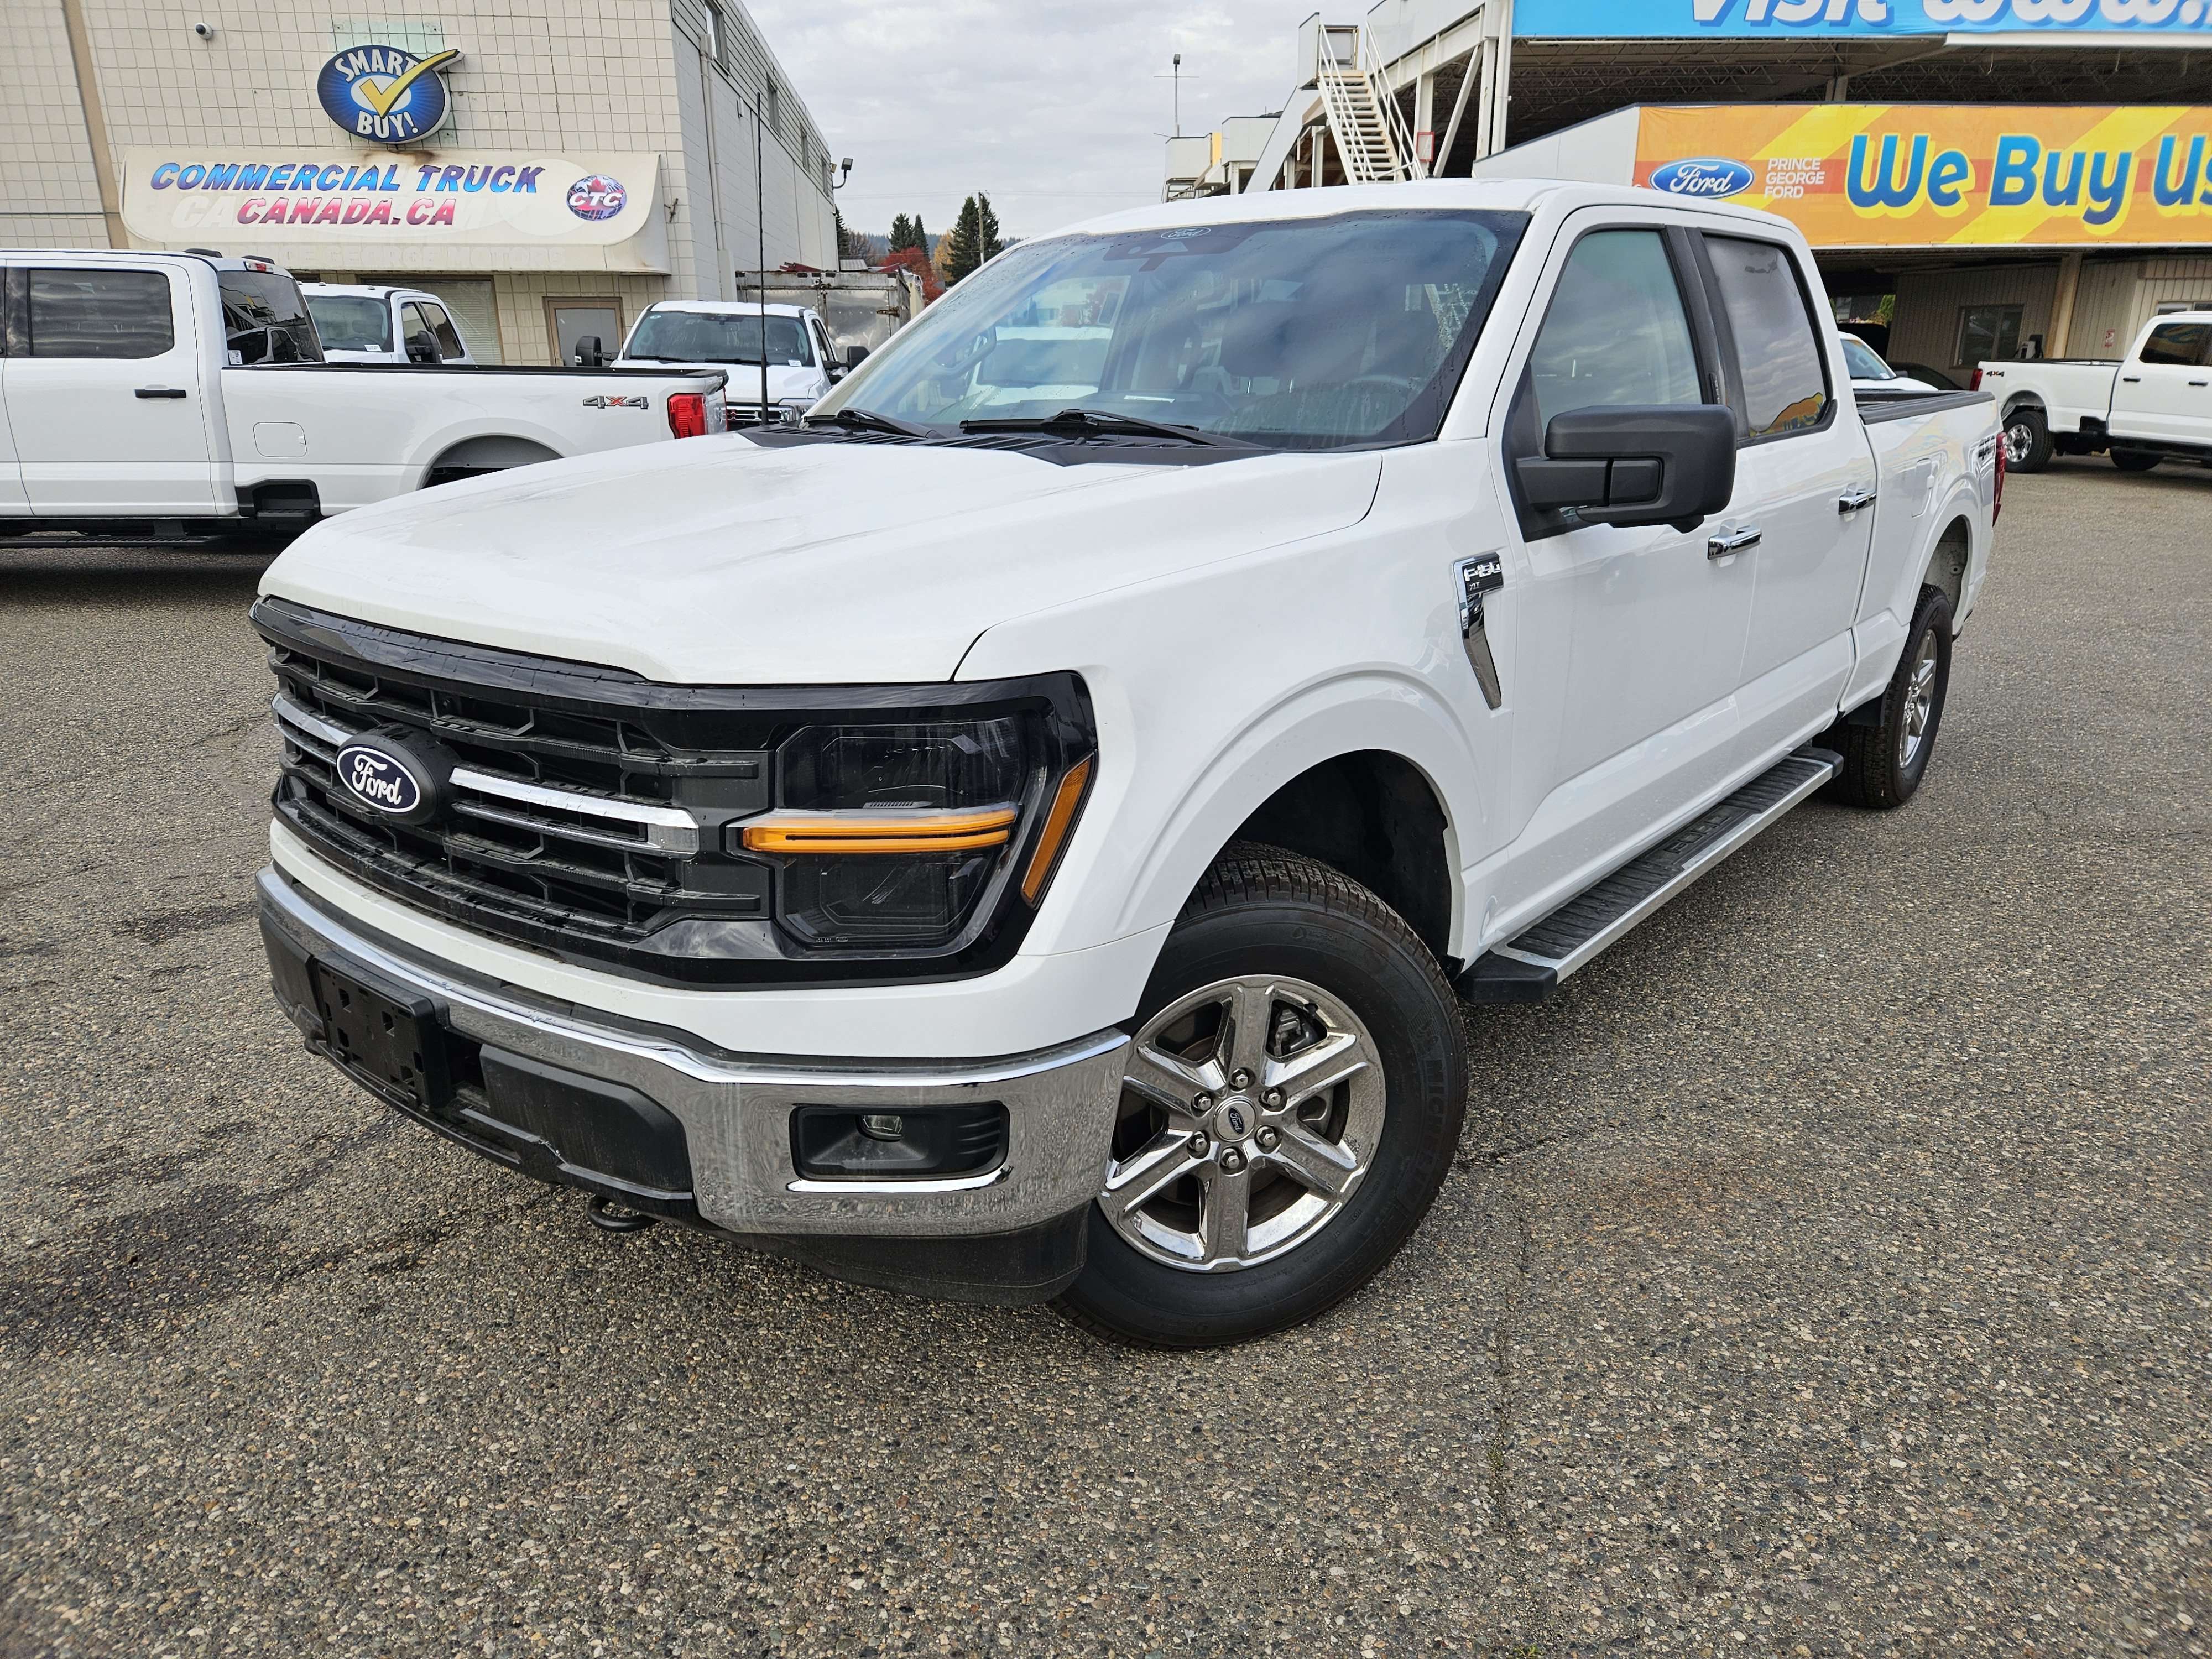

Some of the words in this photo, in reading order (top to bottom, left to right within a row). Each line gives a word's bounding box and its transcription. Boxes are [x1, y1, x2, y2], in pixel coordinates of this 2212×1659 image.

[335, 49, 419, 82] SMART
[357, 110, 419, 138] BUY!
[150, 162, 400, 191] COMMERCIAL
[416, 164, 545, 193] TRUCK
[1670, 164, 1735, 193] Ford
[1766, 171, 1825, 184] GEORGE
[1767, 158, 1823, 171] PRINCE
[1763, 185, 1805, 199] FORD
[1847, 134, 1969, 208] We
[1988, 134, 2133, 225] Buy
[237, 197, 457, 225] CANADA.CA
[569, 191, 623, 207] CTC
[352, 754, 402, 805] Ford
